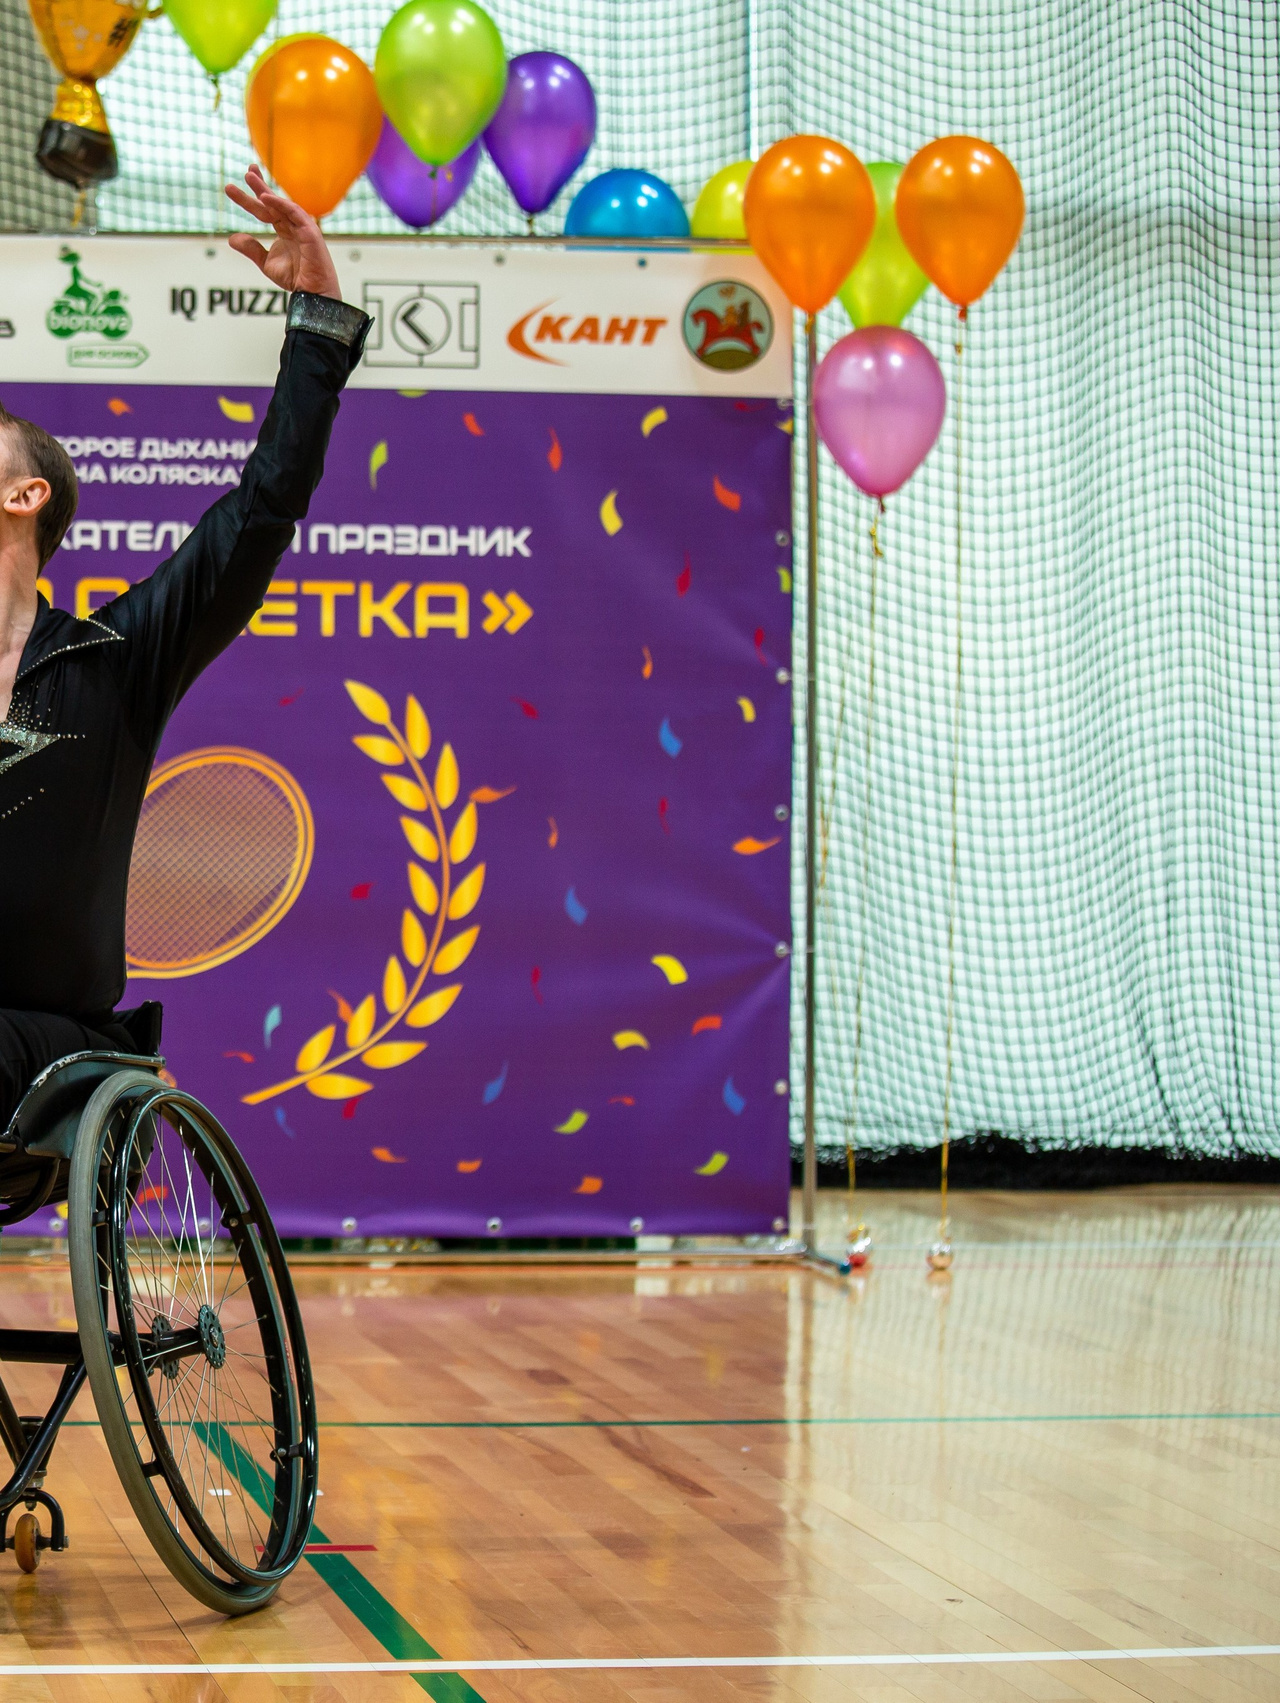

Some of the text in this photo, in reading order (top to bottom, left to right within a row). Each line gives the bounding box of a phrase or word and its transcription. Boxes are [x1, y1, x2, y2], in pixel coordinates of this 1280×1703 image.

[170, 287, 197, 321] IQ
[534, 314, 669, 346] КАНТ
[137, 437, 260, 462] ДЫХАНИ
[109, 463, 248, 487] КОЛЯСКА
[308, 523, 533, 558] ПРАЗДНИК
